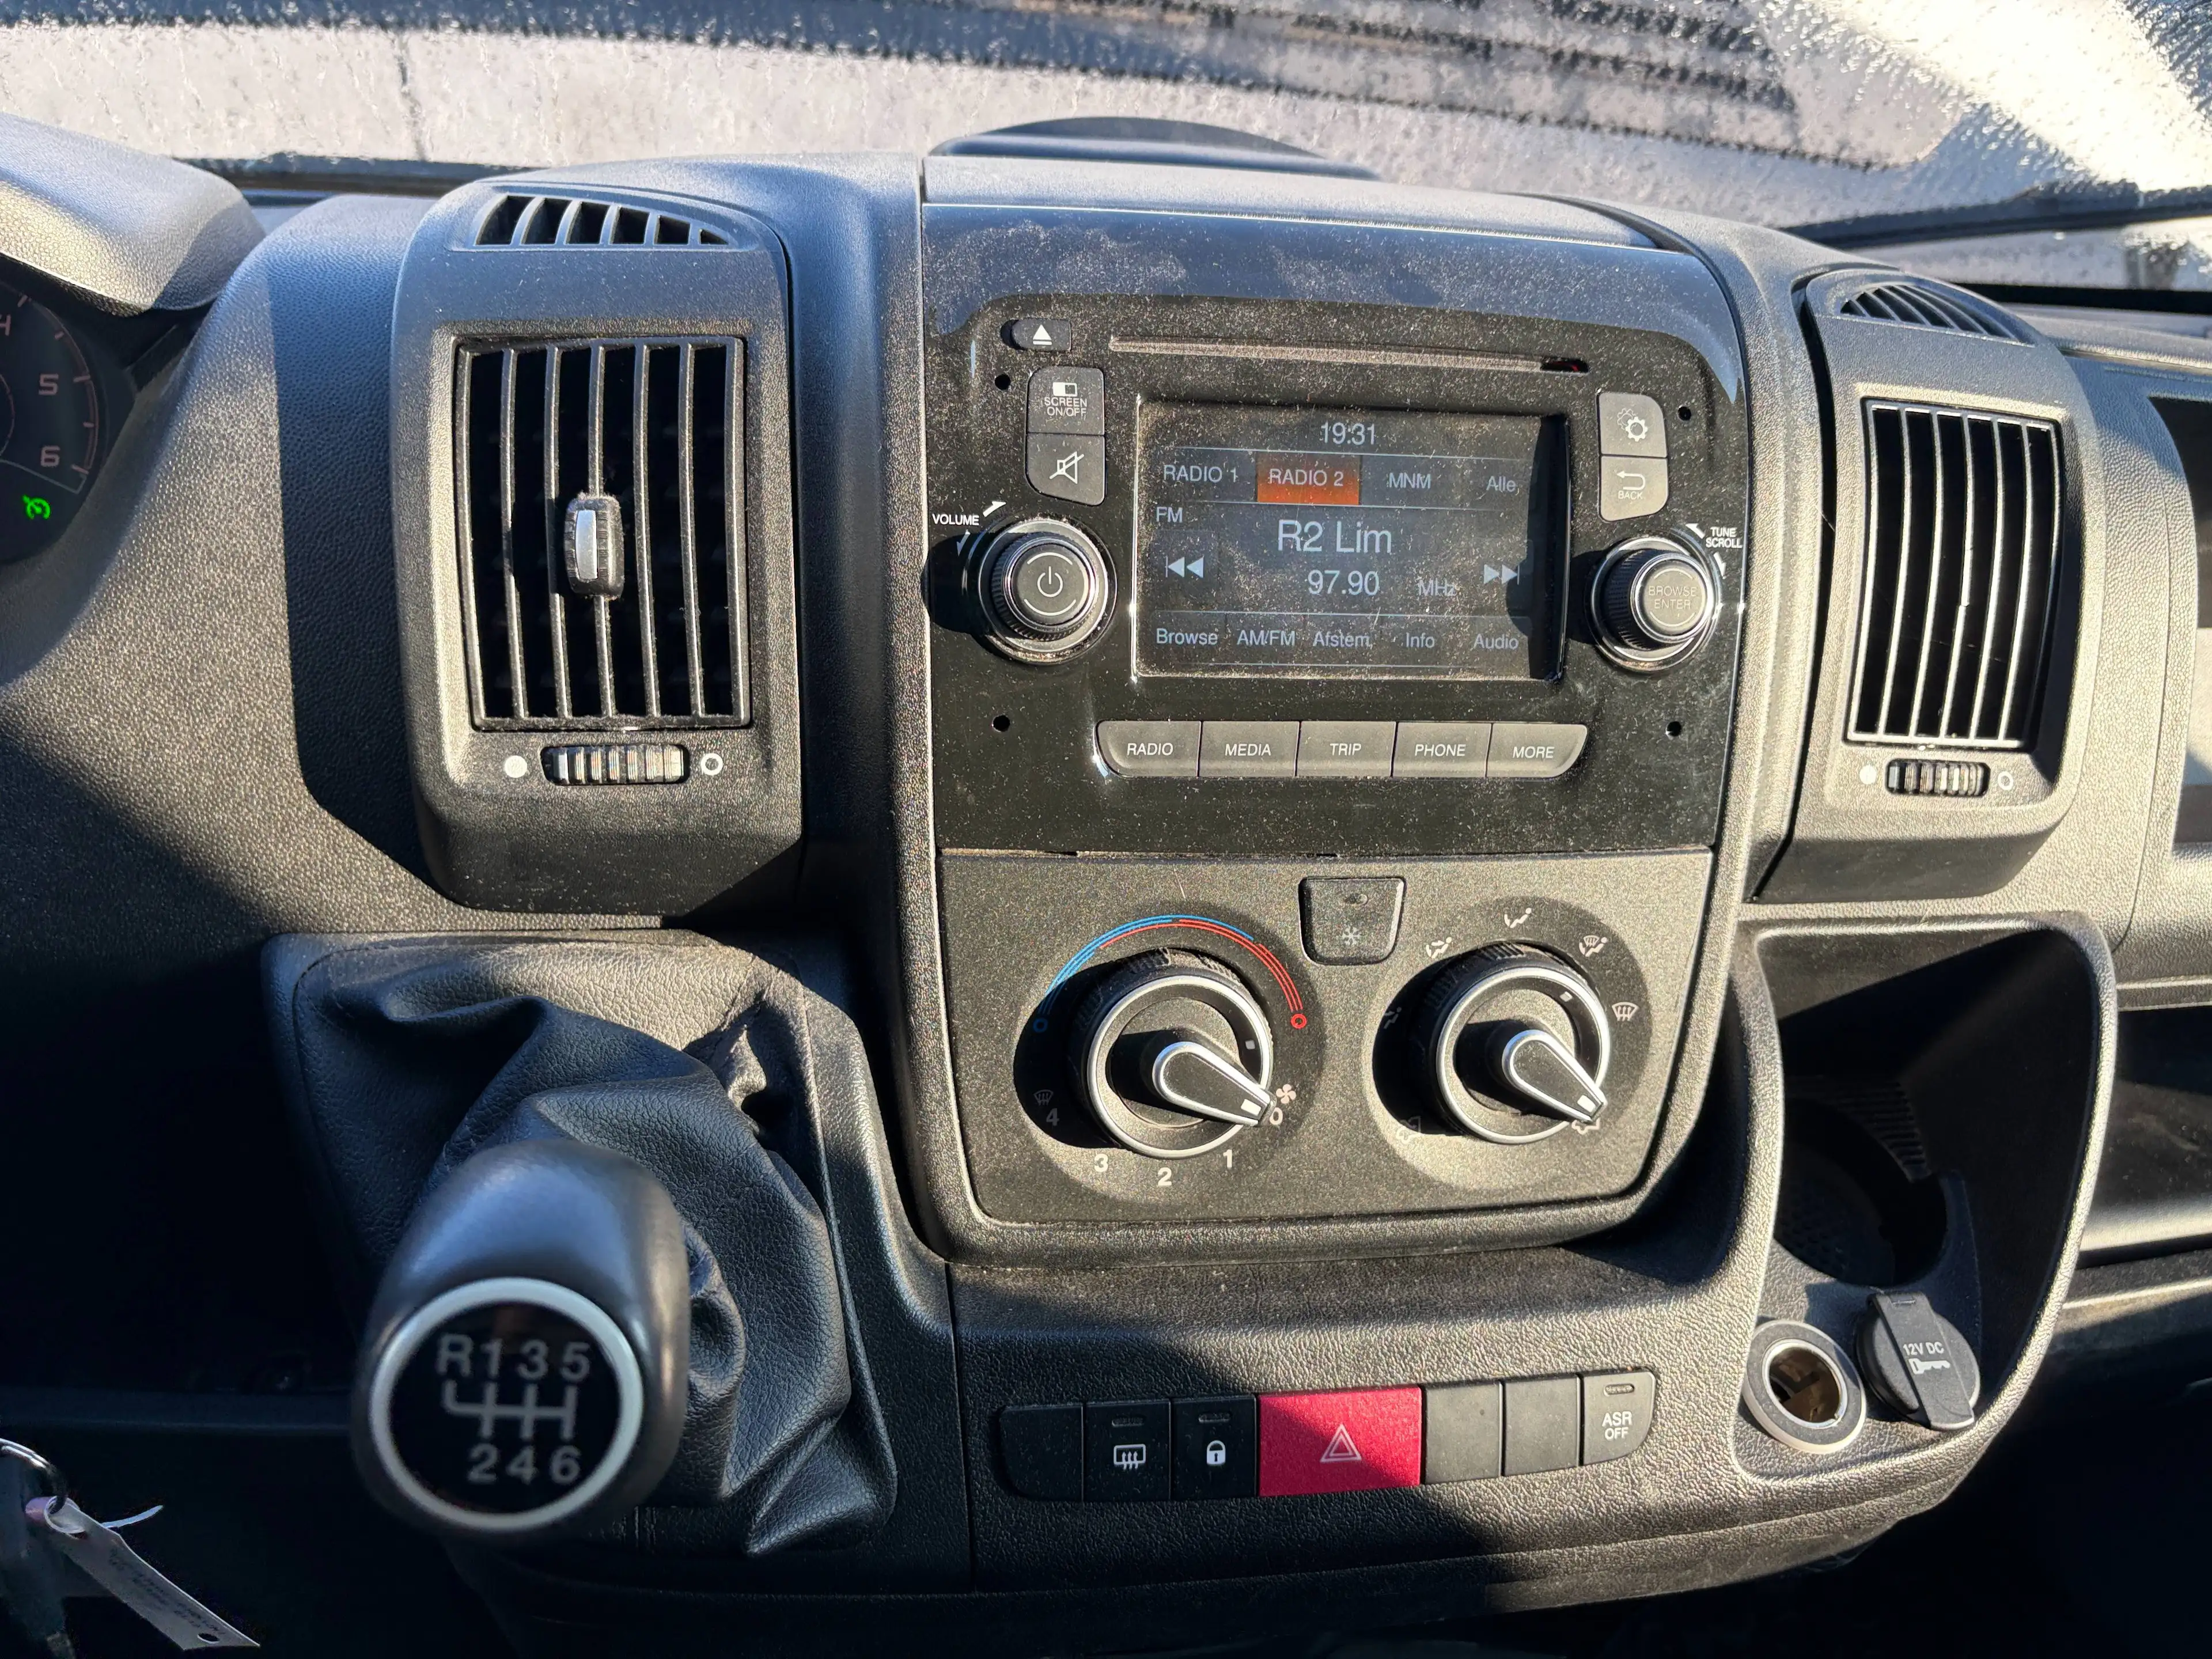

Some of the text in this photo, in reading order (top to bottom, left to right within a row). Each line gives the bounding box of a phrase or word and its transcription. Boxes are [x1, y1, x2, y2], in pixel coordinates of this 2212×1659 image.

[38, 374, 58, 395] 5
[1044, 396, 1088, 408] SCREEN
[1047, 407, 1086, 417] ON/OFF
[1321, 422, 1376, 446] 19:31
[40, 445, 60, 467] 6
[1163, 464, 1237, 483] RADIO 1
[1269, 468, 1344, 487] RADIO 2
[1388, 472, 1431, 489] MNM
[1486, 476, 1517, 493] Alle
[1618, 491, 1643, 500] BACK
[932, 513, 979, 526] VOLUME
[1156, 507, 1183, 523] FM
[1278, 520, 1392, 554] R2 Lim
[1710, 527, 1737, 537] TUNE
[1706, 537, 1743, 548] SCROLL
[1308, 570, 1456, 597] 97.90 MHz
[1648, 585, 1697, 597] BROWSE
[1654, 599, 1691, 609] ENTER
[1156, 628, 1218, 645] Browse
[1237, 630, 1296, 646] AM/FM
[1406, 632, 1435, 649] Info
[1474, 633, 1519, 650] Audio
[1127, 743, 1173, 756] RADIO
[1225, 743, 1271, 757] MEDIA
[1330, 743, 1362, 756] TRIP
[1414, 744, 1466, 757] PHONE
[1512, 745, 1554, 759] MORE
[1046, 1107, 1059, 1126] 4
[1094, 1153, 1109, 1173] 3
[1223, 1149, 1233, 1168] 1
[1158, 1167, 1172, 1187] 2
[1903, 1342, 1944, 1356] 12V DC
[1601, 1411, 1633, 1427] ASR
[1604, 1427, 1628, 1440] OFF
